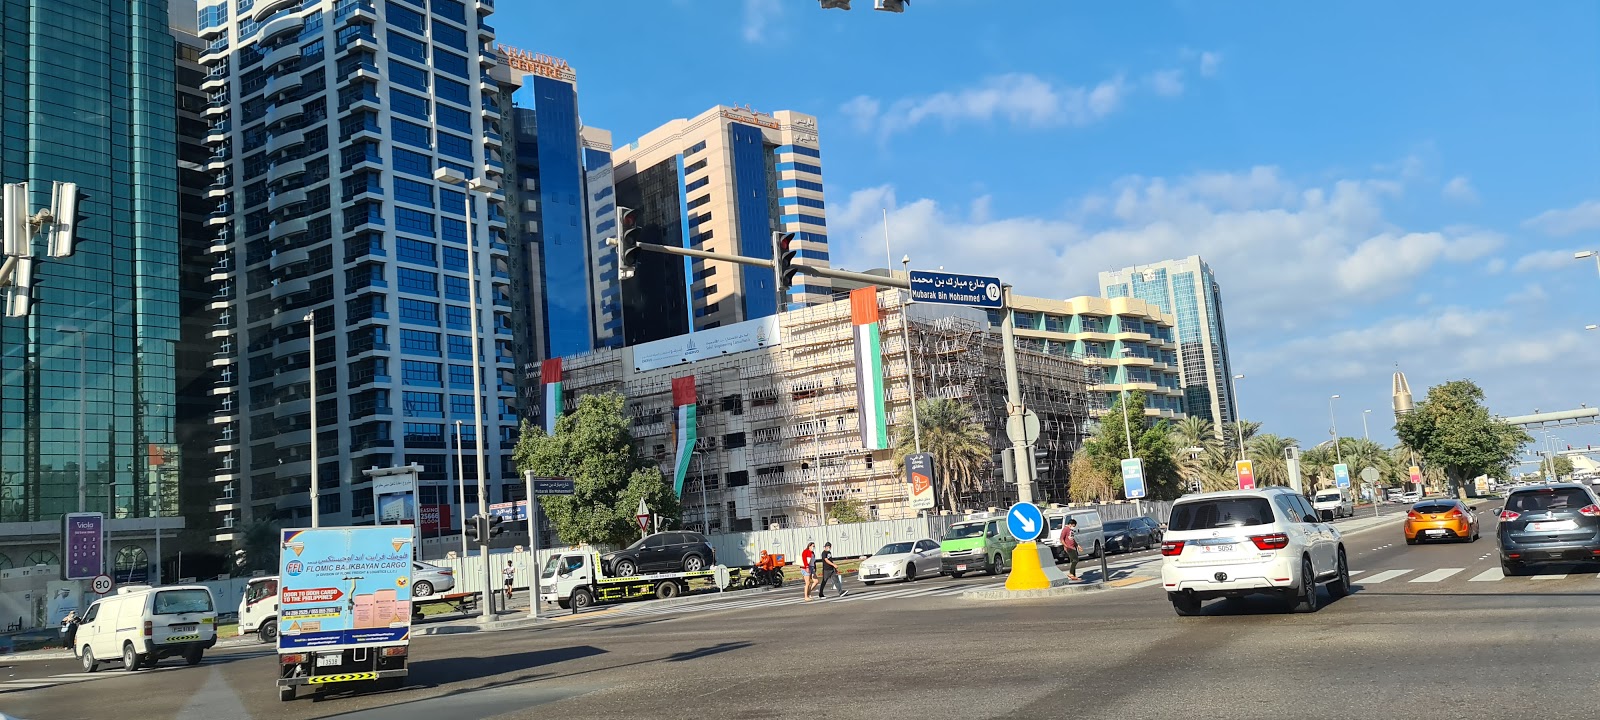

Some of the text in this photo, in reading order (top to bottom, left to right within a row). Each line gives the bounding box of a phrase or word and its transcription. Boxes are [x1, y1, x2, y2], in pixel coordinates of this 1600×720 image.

[497, 43, 571, 71] KHALIDIYA
[508, 58, 563, 80] CENTRE
[911, 275, 986, 292] شارع مبارك بن محمد
[912, 289, 937, 299] Mubarak
[938, 291, 947, 300] Bin
[948, 292, 980, 302] Mohammed
[988, 286, 998, 298] 12
[76, 521, 94, 529] Viola
[286, 562, 302, 573] FFL
[305, 564, 334, 573] FLOMIC
[380, 561, 407, 569] CARGO
[95, 580, 110, 589] 80
[302, 594, 333, 602] PHILIPPINES
